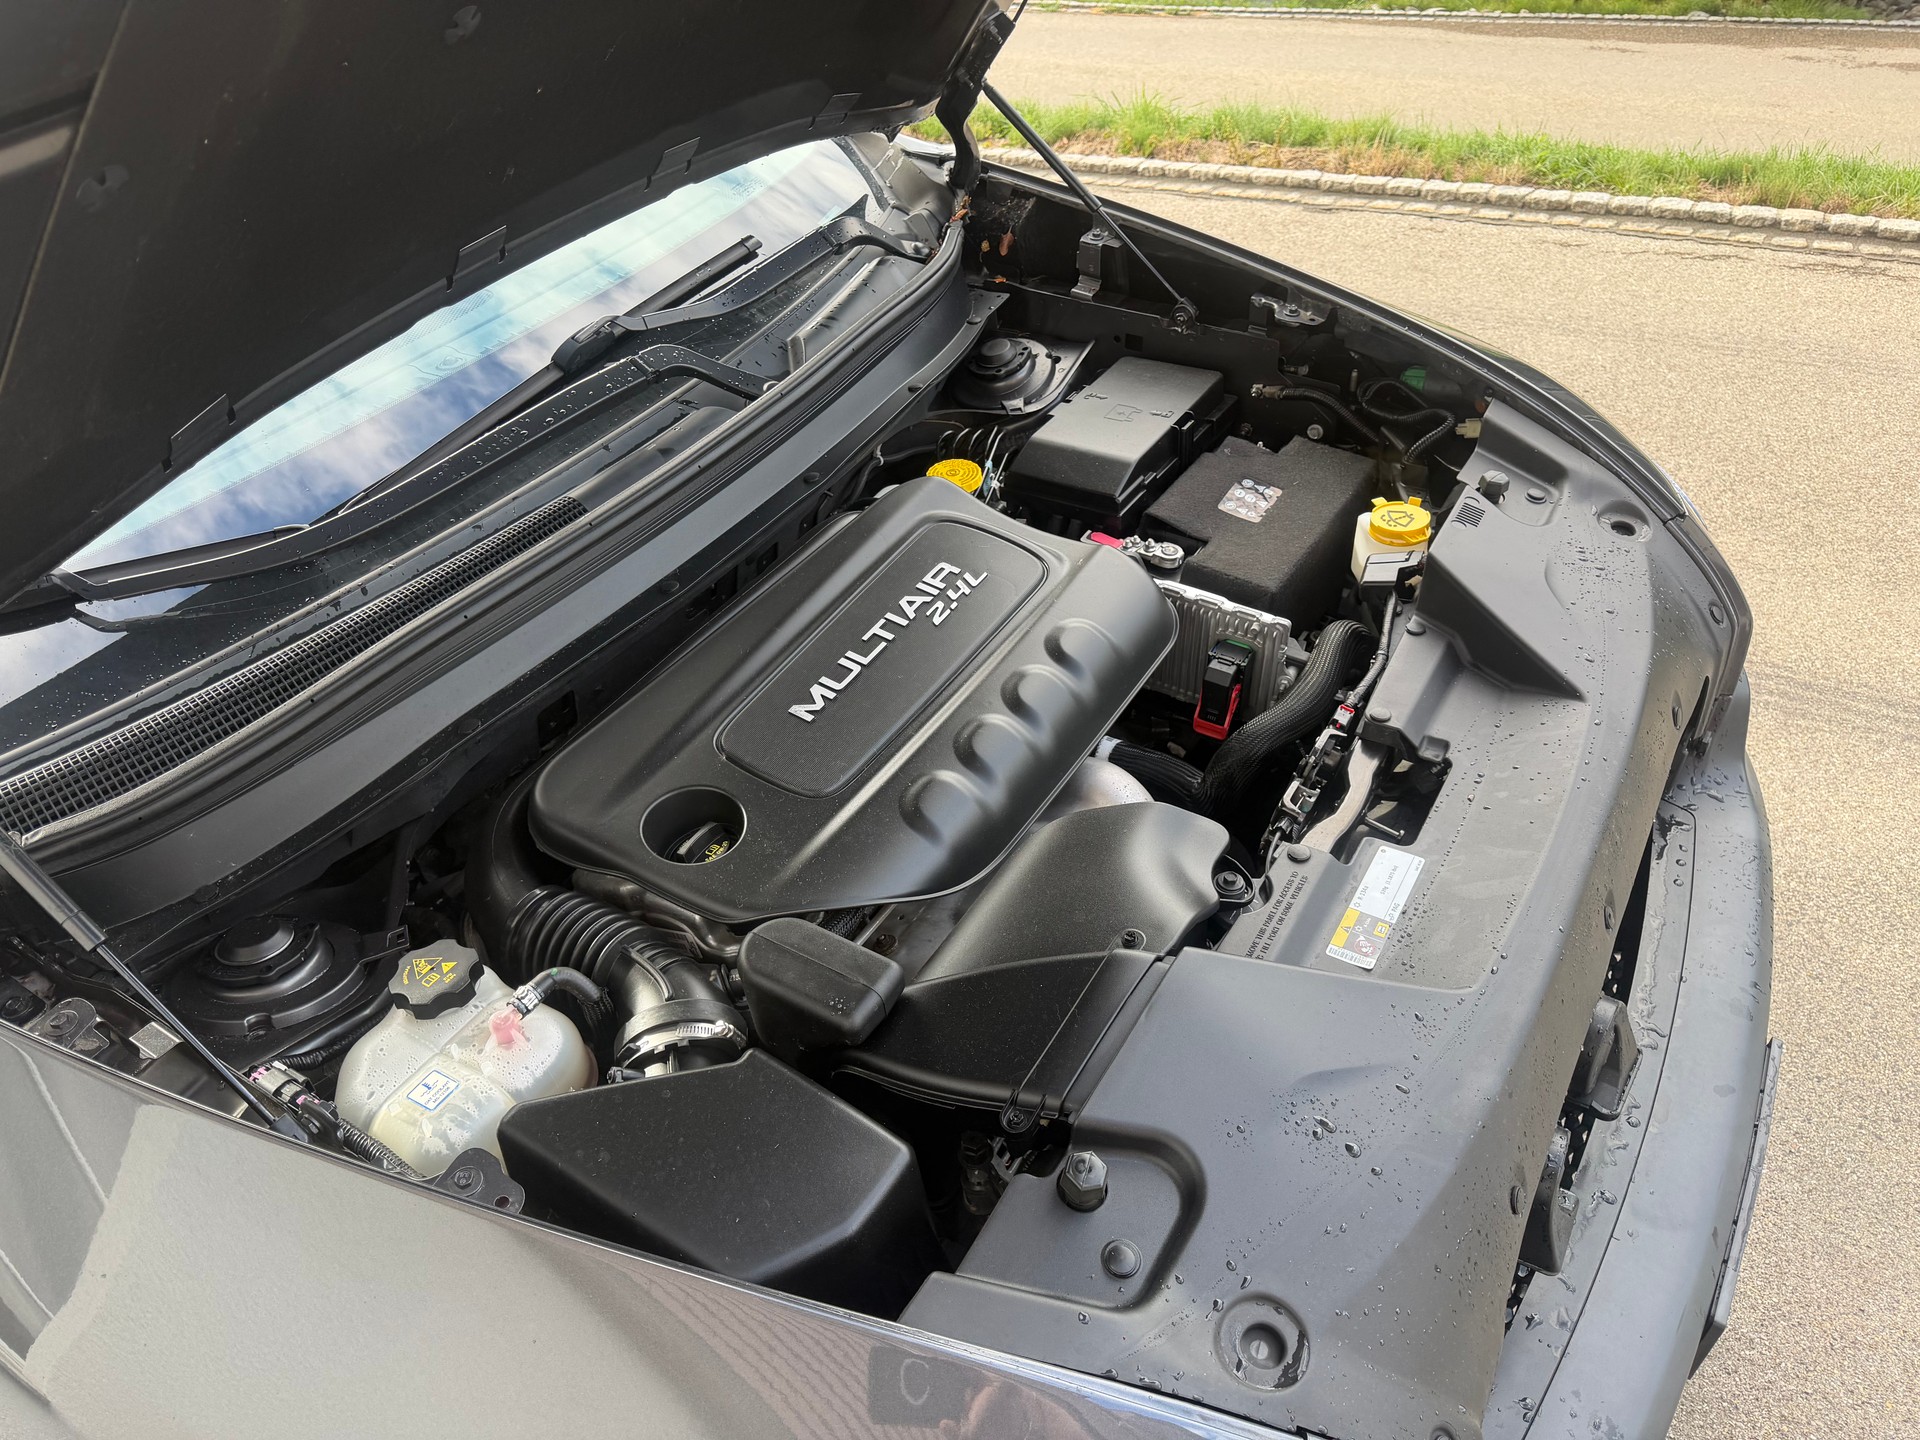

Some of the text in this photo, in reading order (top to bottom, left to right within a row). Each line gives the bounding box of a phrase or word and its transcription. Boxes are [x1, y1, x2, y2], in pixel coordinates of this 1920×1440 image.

[925, 572, 989, 626] 2.4L
[788, 561, 961, 723] MULTIAIR
[1255, 928, 1268, 940] THIS
[1263, 910, 1278, 928] PANEL
[1273, 899, 1284, 910] FOR
[1279, 879, 1295, 900] ACCESS
[1268, 927, 1280, 941] PORT
[1281, 902, 1294, 917] SOME
[431, 1080, 450, 1097] COOLANT
